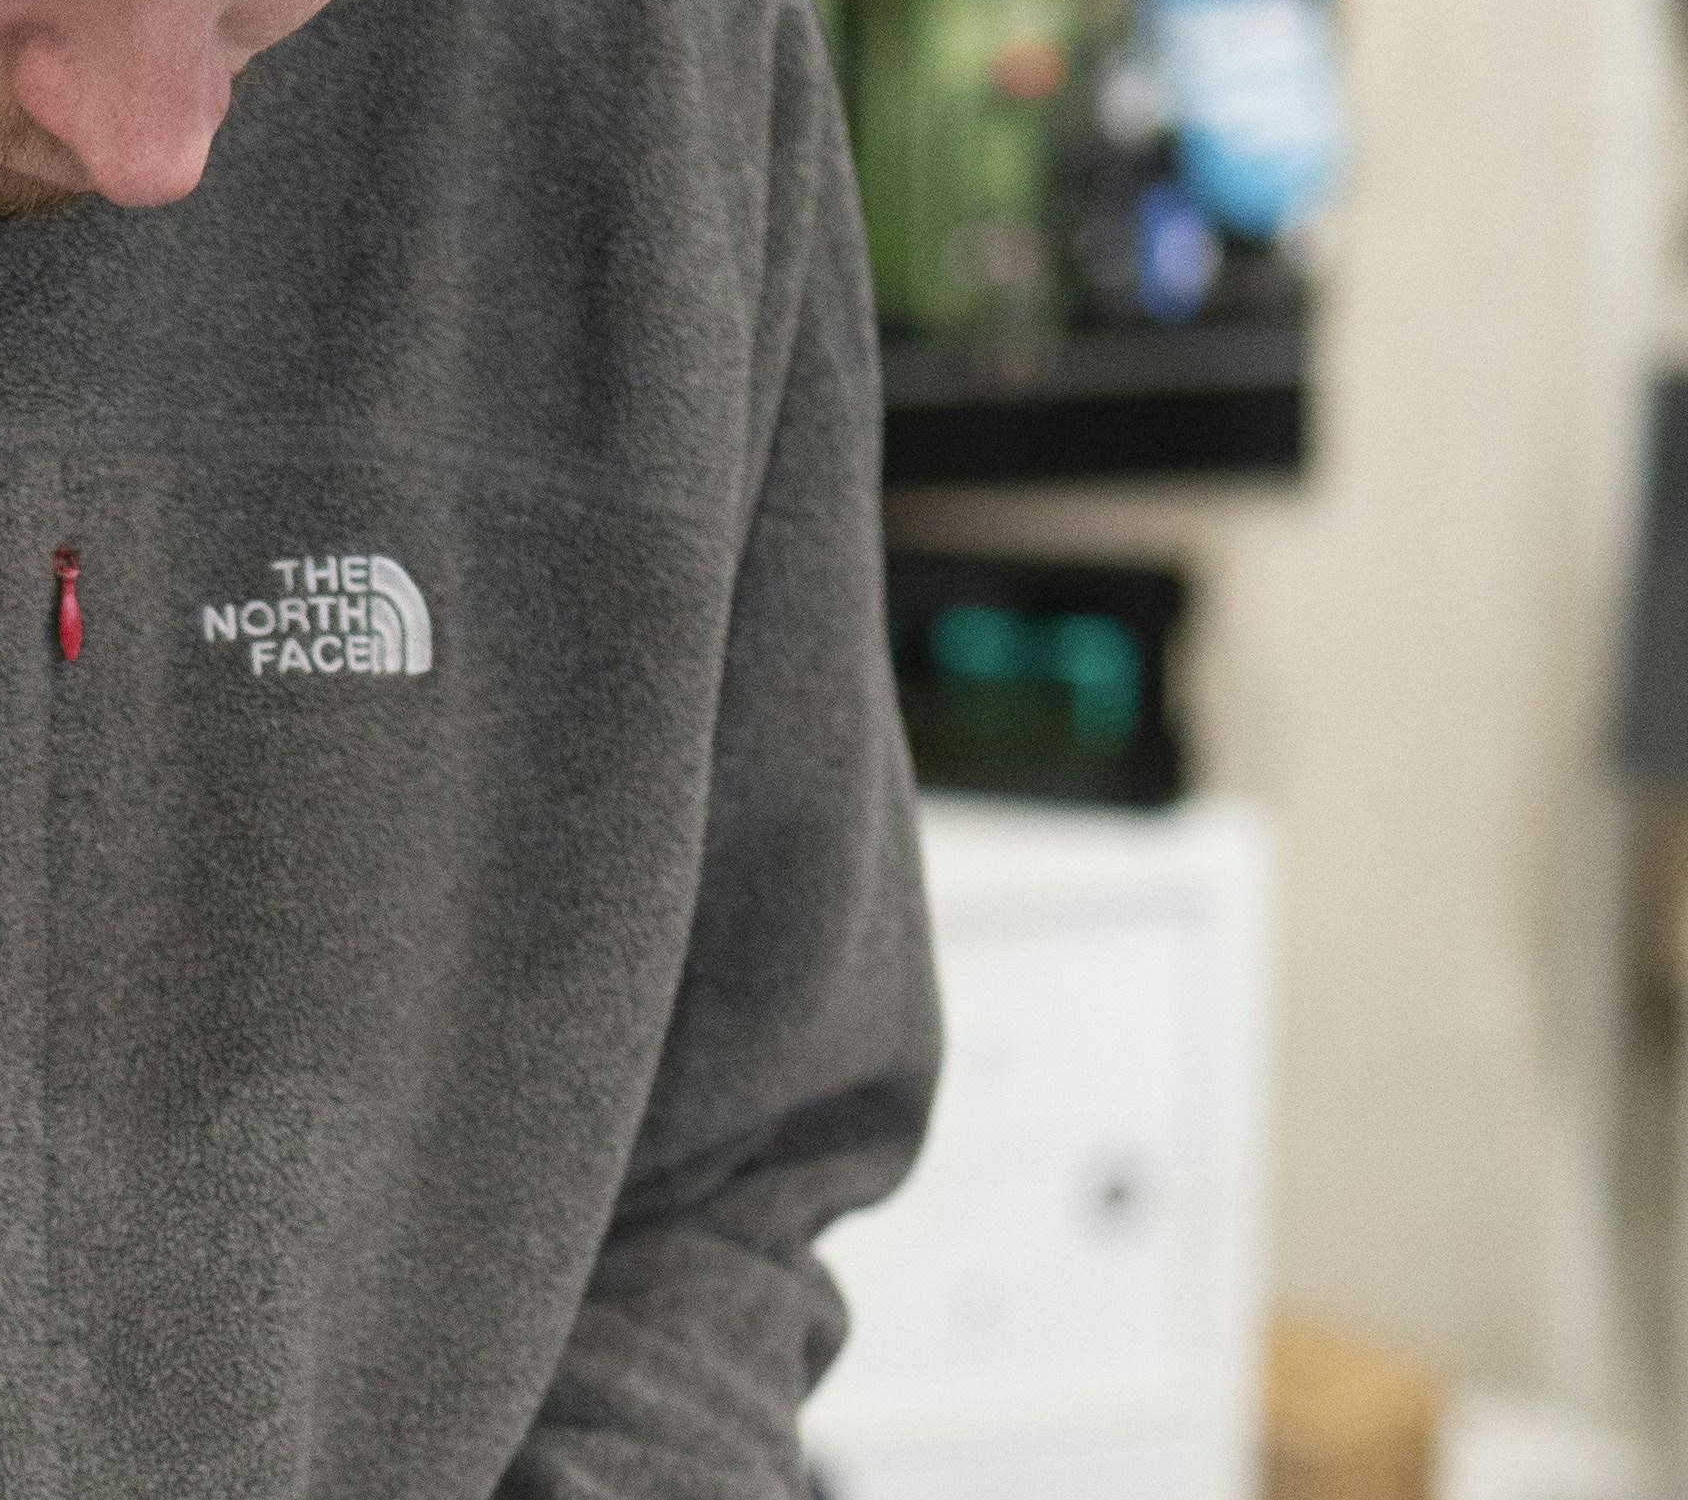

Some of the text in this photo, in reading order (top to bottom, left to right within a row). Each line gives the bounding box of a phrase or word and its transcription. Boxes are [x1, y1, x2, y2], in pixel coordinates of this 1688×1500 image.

[271, 556, 368, 592] THE
[202, 598, 366, 641] NORTH
[250, 635, 374, 676] FACE
